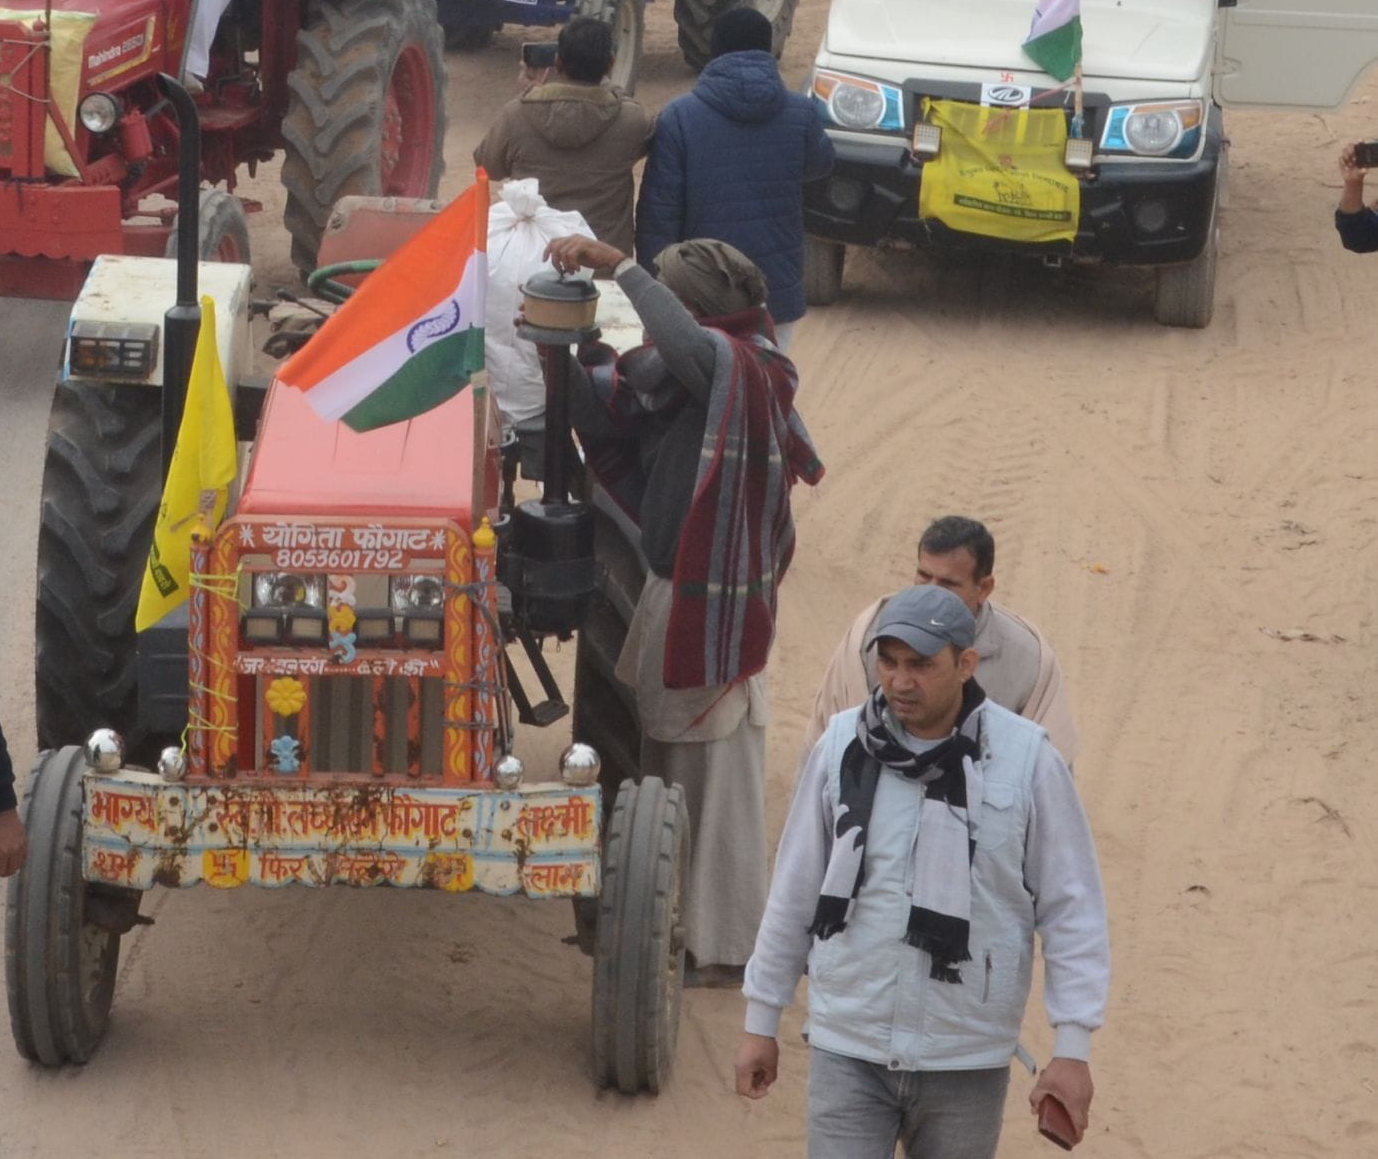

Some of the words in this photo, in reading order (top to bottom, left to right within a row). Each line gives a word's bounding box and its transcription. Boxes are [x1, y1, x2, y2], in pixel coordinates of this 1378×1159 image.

[87, 45, 122, 69] Mahindra
[262, 521, 346, 549] योगिता
[276, 549, 404, 569] 8053601792
[91, 791, 158, 832] भाग्य
[258, 855, 305, 881] फिर
